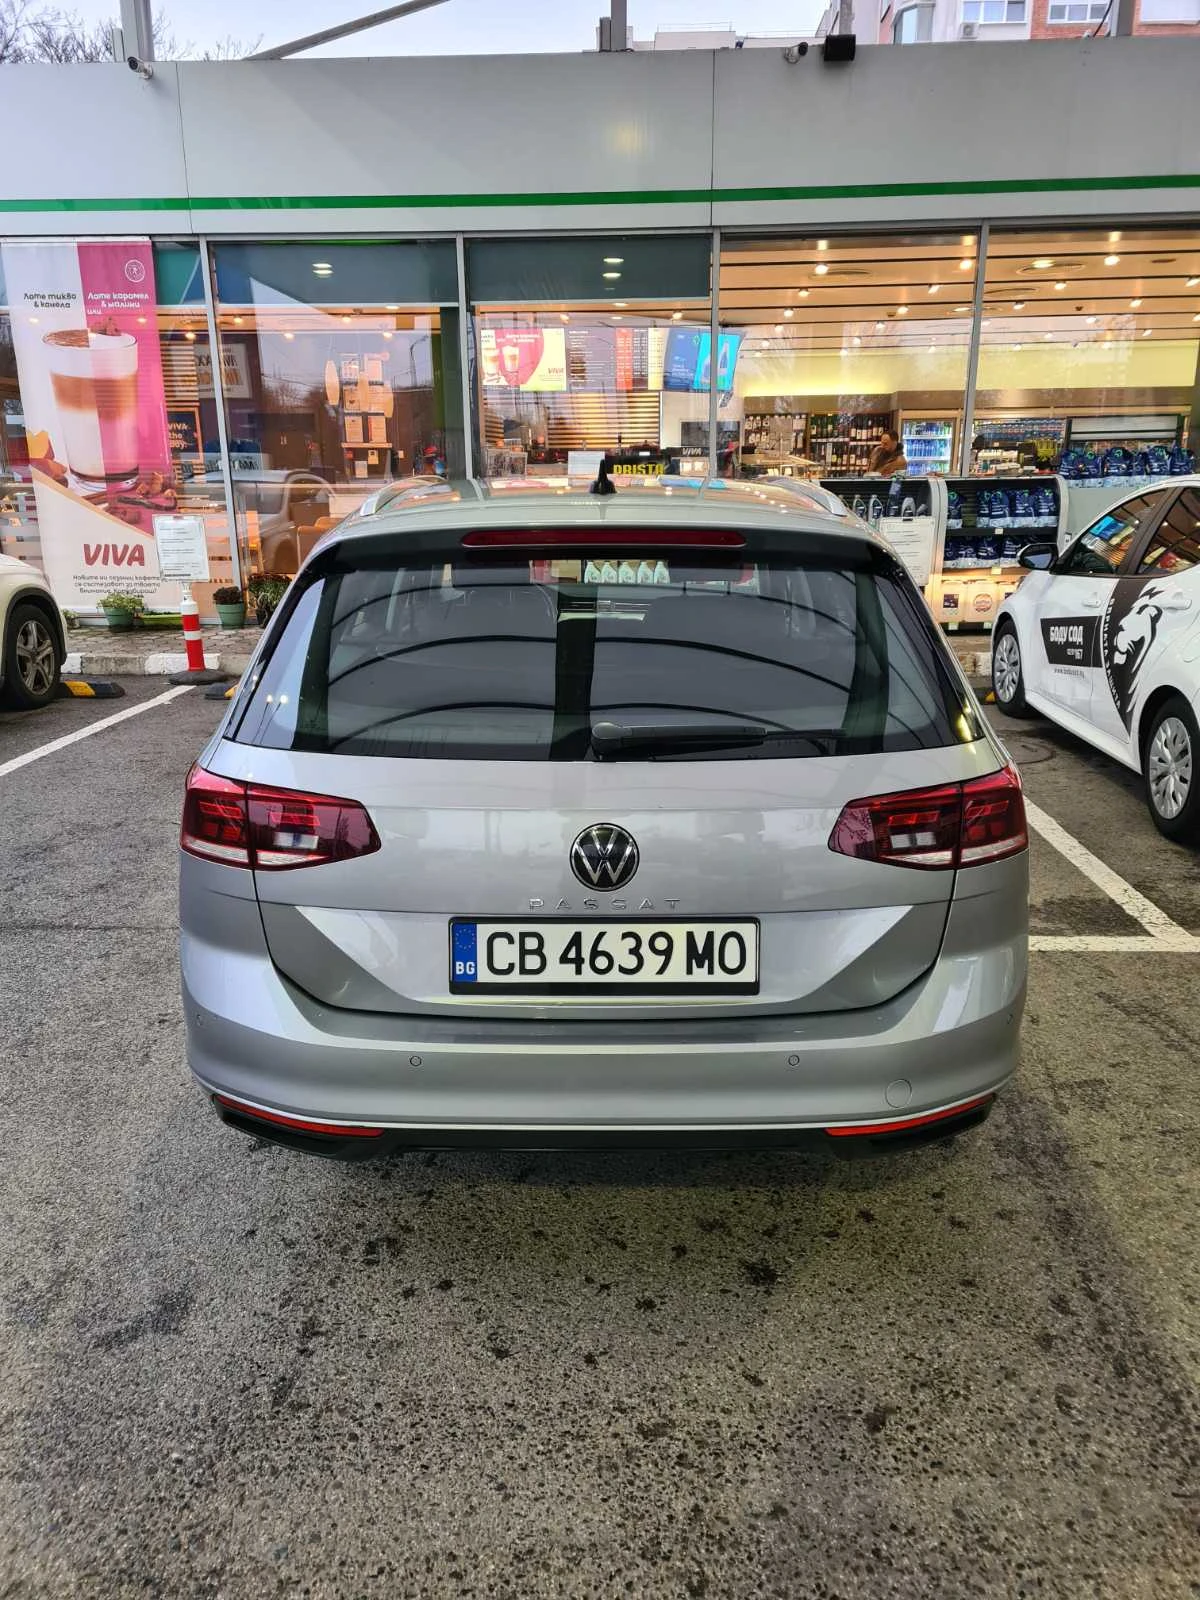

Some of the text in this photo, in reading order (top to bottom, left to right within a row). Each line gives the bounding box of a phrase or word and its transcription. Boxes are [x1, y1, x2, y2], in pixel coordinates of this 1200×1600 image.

[83, 544, 146, 566] VIVA
[528, 898, 681, 912] PASSAT
[486, 930, 747, 976] CB 4639 MO
[456, 960, 475, 975] BG
